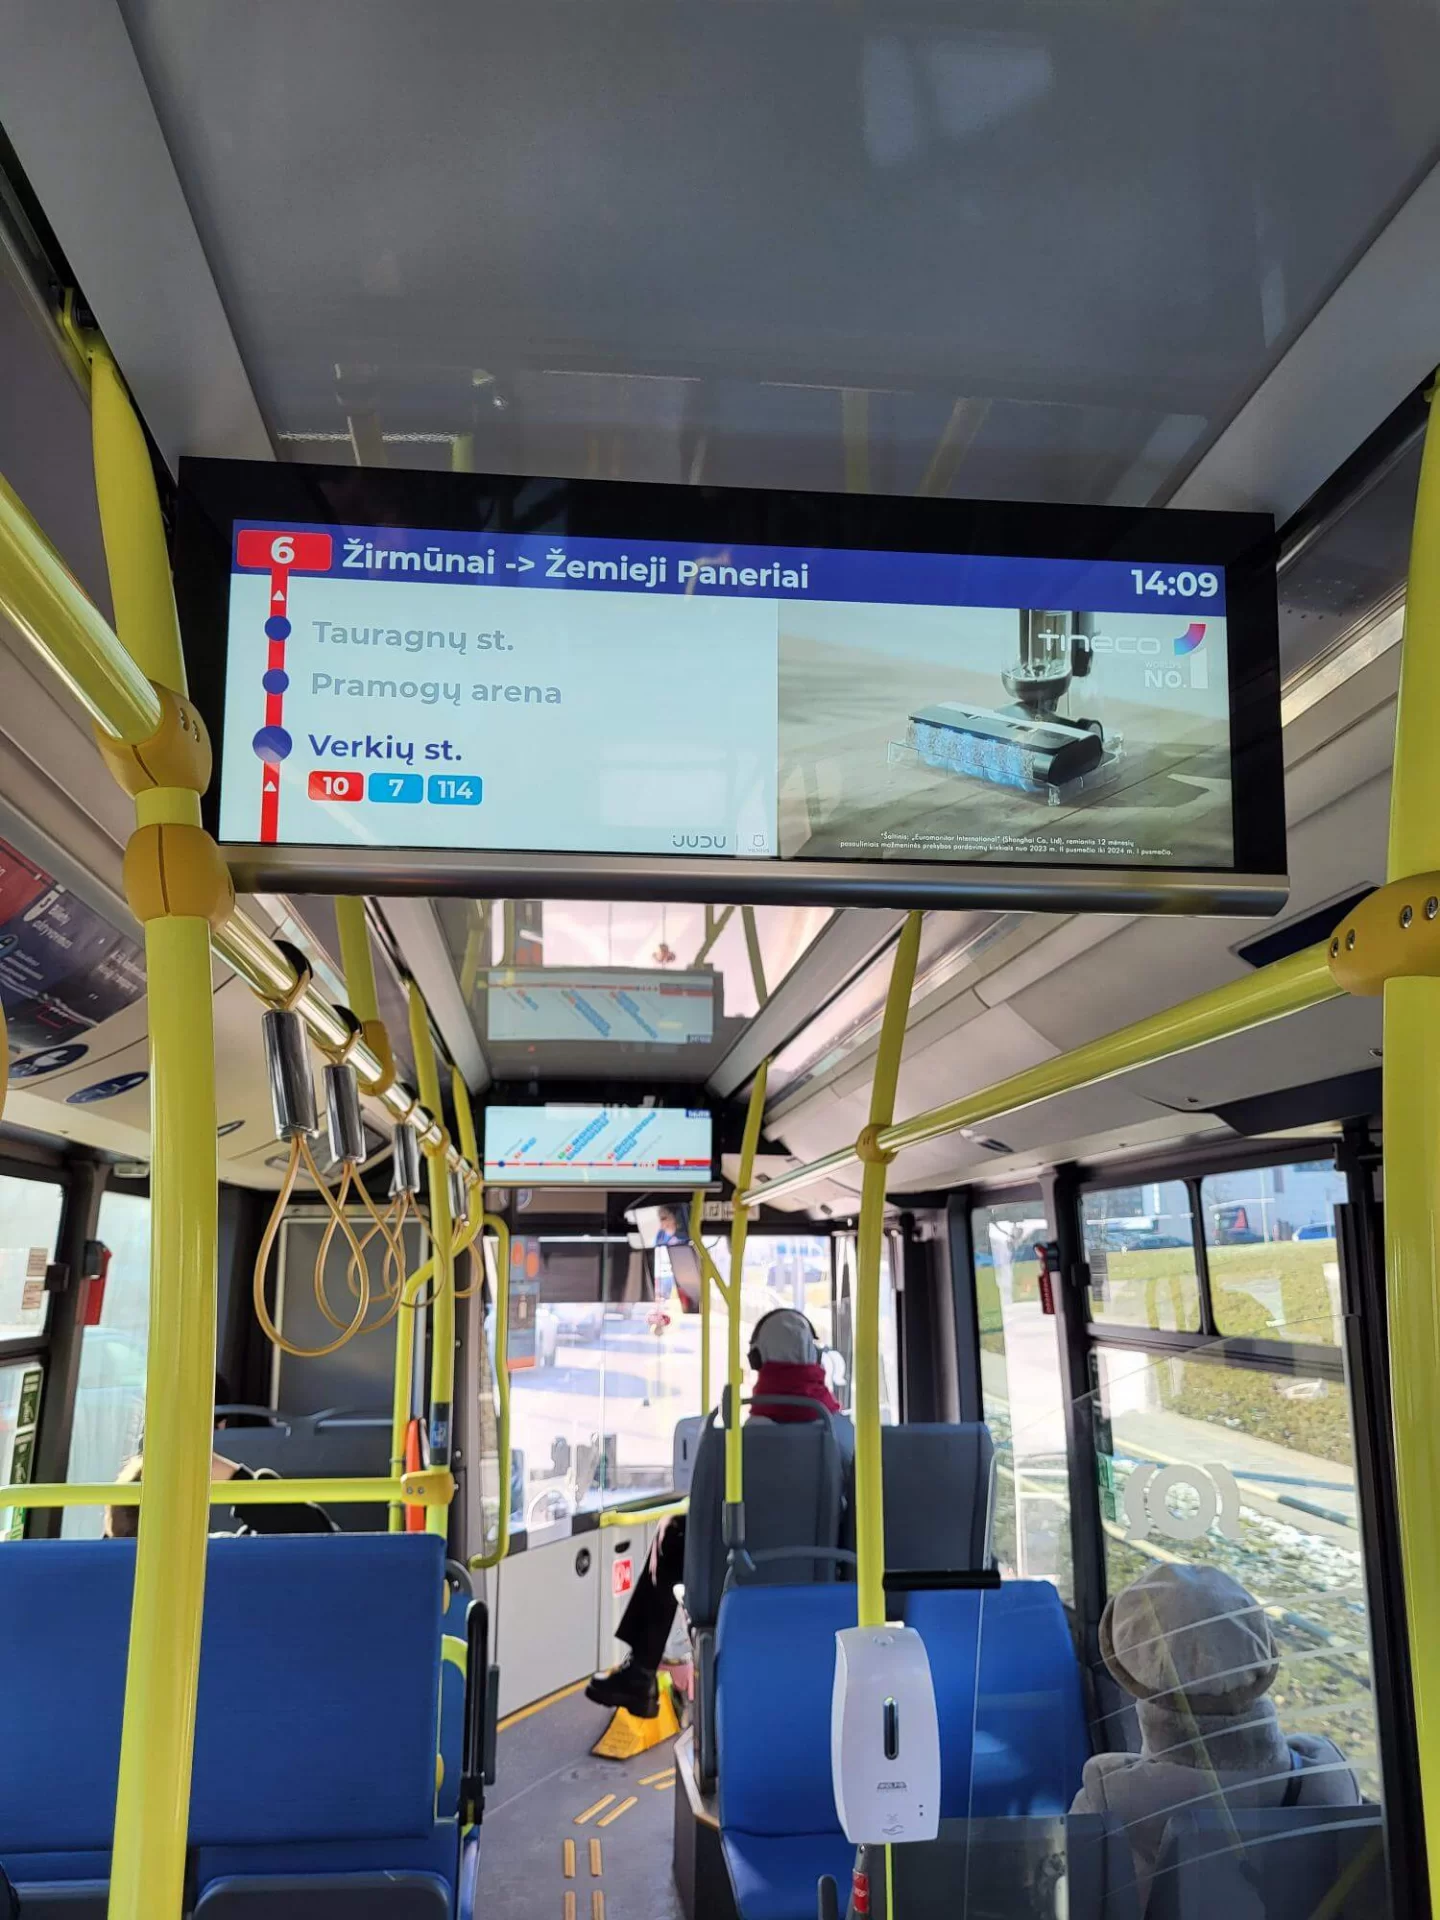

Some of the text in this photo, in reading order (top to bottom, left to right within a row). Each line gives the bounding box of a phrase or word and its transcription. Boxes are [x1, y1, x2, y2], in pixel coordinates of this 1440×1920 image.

[270, 536, 295, 564] 6
[342, 538, 495, 574] Žirmūnai
[545, 548, 666, 588] Žemieji
[678, 560, 808, 589] Paneriai
[1131, 569, 1218, 597] 14:09
[311, 620, 514, 656] Tauragnų st.
[311, 672, 562, 707] Pramogų arena
[307, 733, 462, 766] Verkių st.
[322, 776, 349, 796] 10
[389, 779, 404, 797] 7
[437, 780, 474, 800] 114
[1029, 845, 1048, 853] 2023
[1107, 847, 1125, 855] 2024
